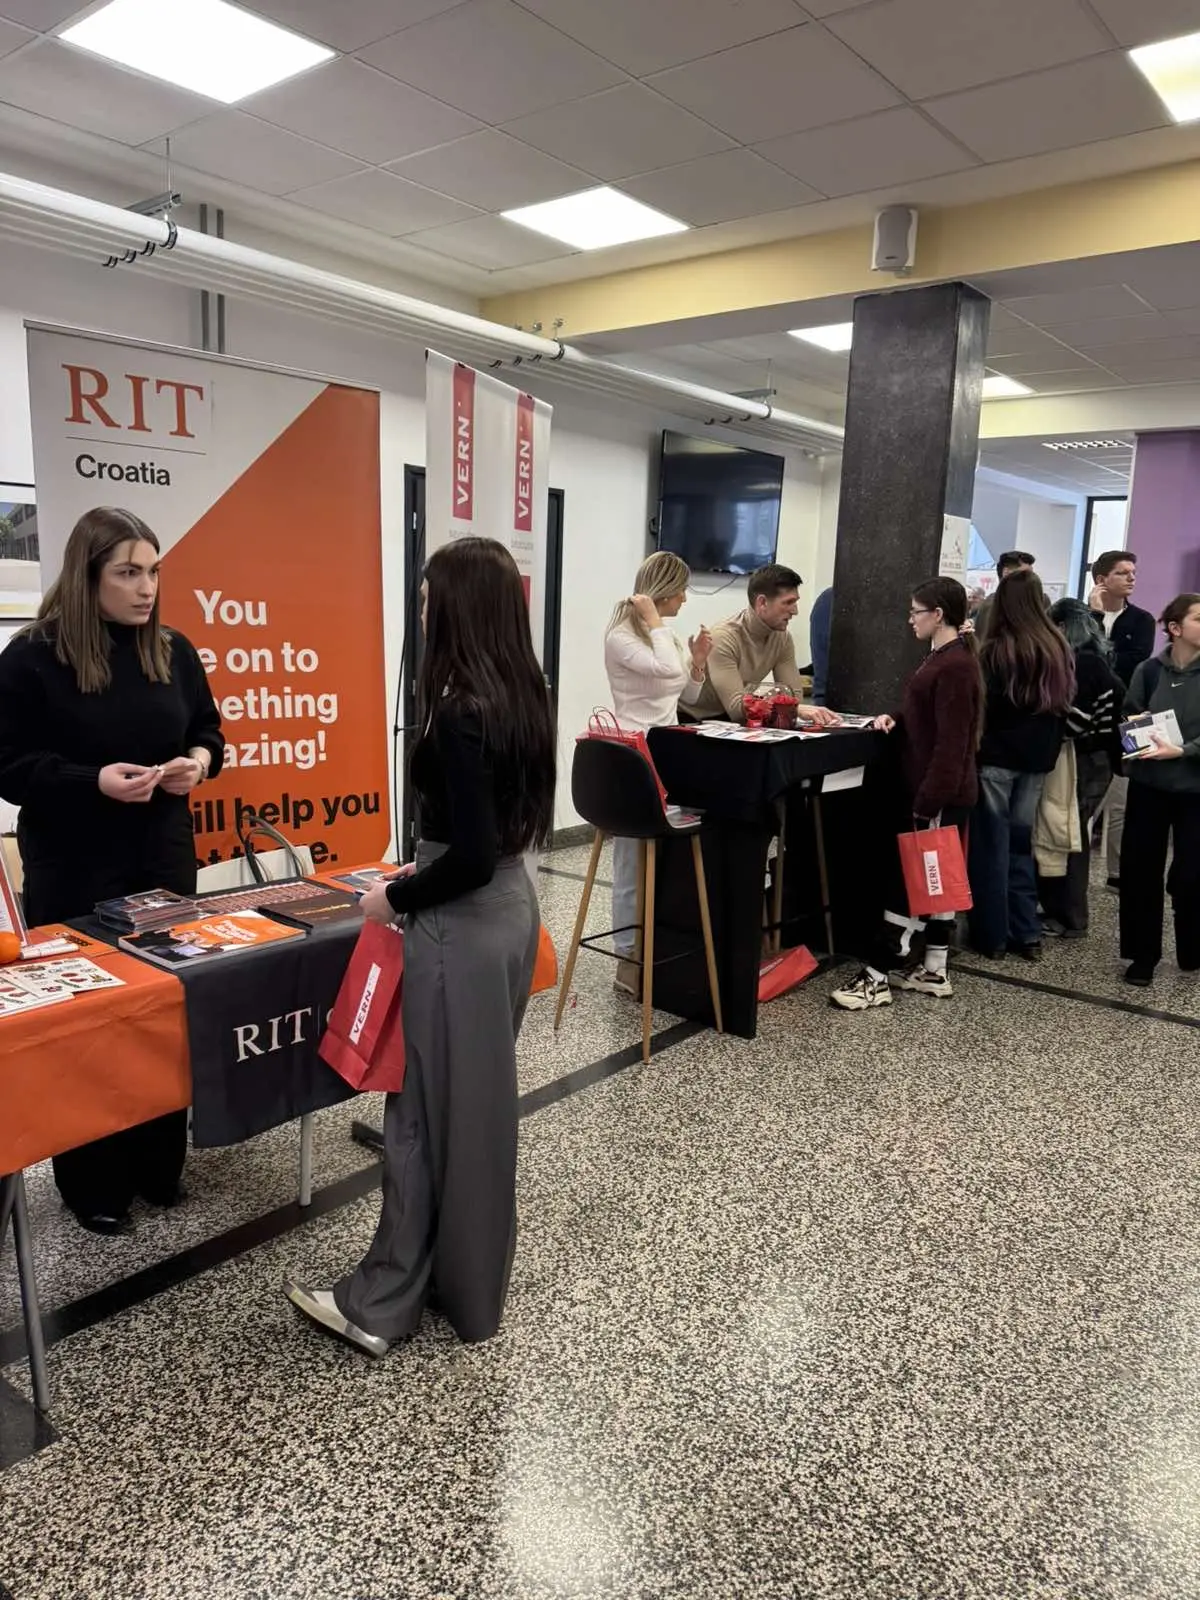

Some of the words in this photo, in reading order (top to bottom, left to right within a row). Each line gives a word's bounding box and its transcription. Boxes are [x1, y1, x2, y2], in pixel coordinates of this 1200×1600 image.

[61, 363, 204, 439] RIT
[75, 453, 171, 487] Croatia
[193, 589, 268, 626] You
[225, 647, 274, 674] on
[281, 641, 319, 673] to
[213, 686, 338, 724] ething
[221, 730, 327, 770] azing!
[193, 798, 225, 834] ill
[234, 792, 315, 830] help
[320, 791, 380, 826] you
[231, 1006, 312, 1063] RIT
